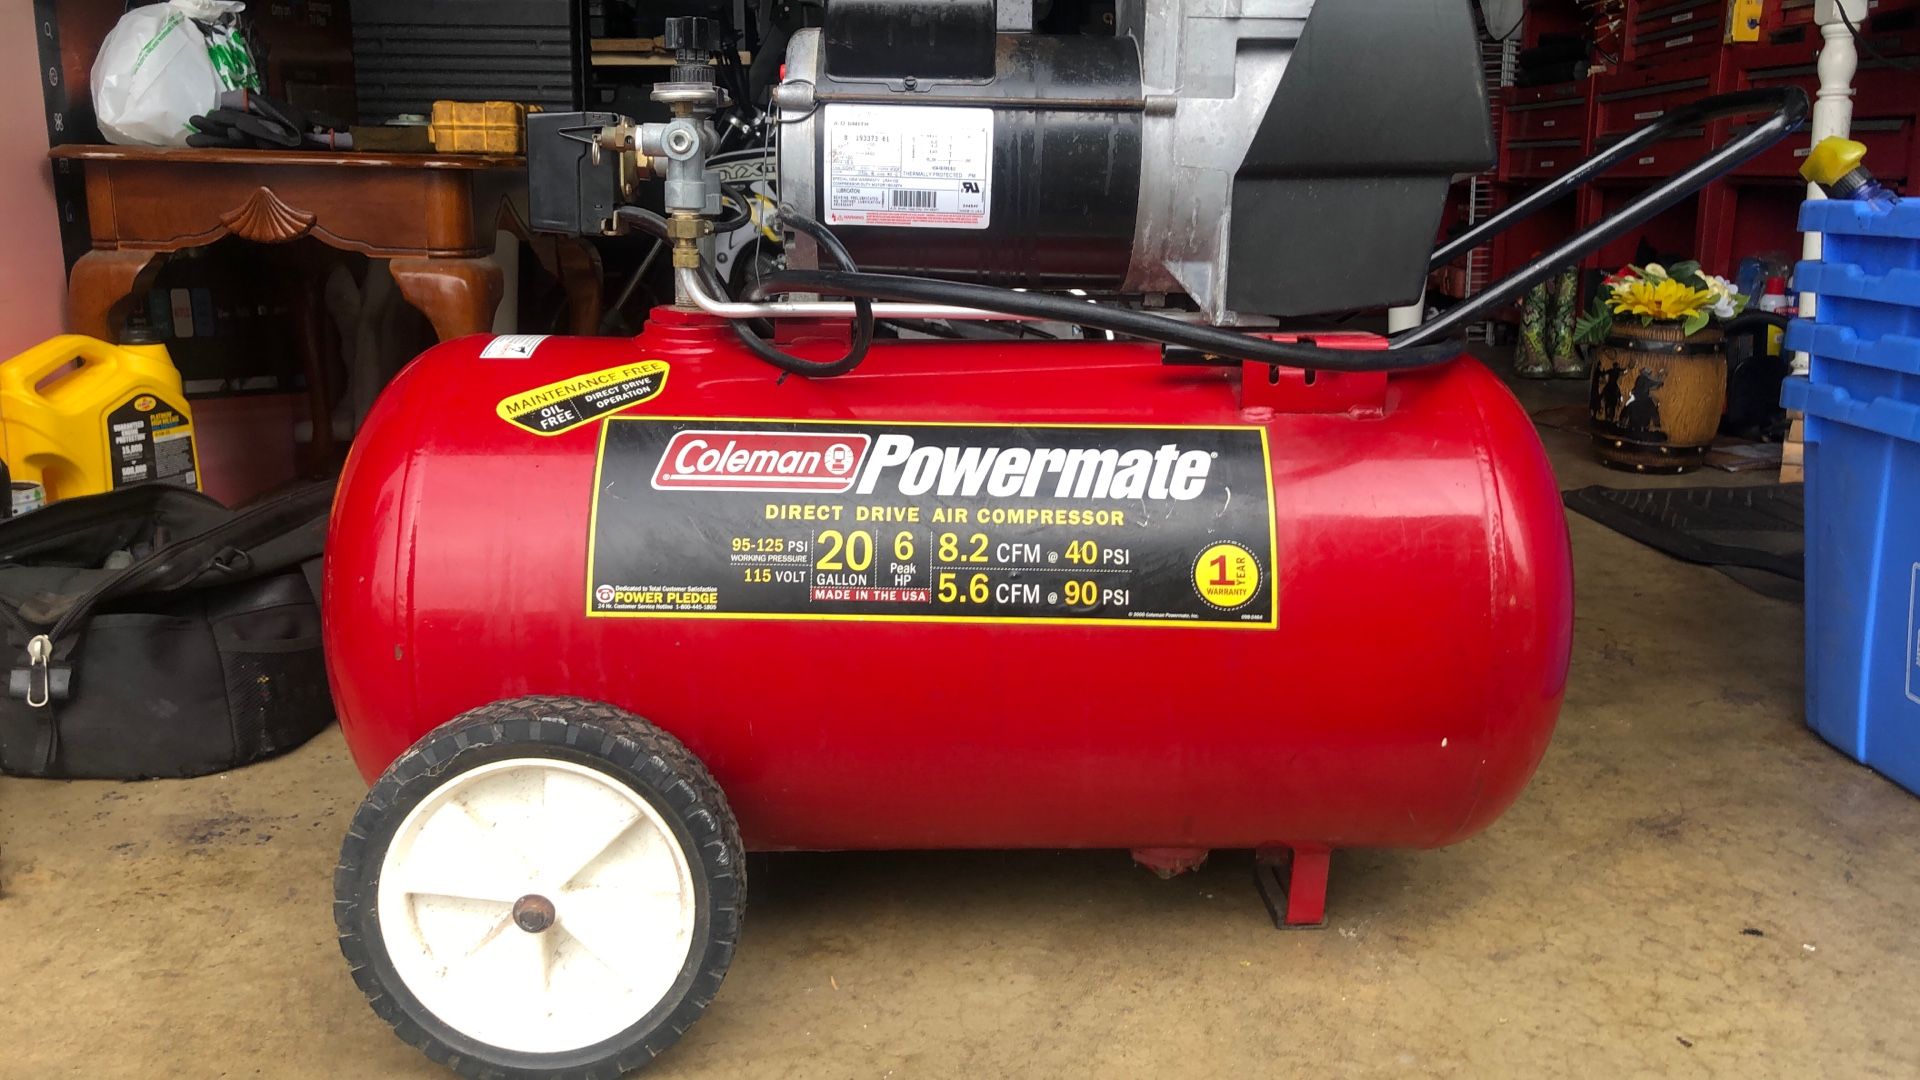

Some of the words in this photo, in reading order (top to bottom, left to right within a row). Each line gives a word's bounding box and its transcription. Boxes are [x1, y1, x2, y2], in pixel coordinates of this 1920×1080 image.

[506, 372, 620, 414] MAINTENANCE
[623, 363, 663, 378] FREE
[585, 386, 620, 403] DIRECT
[622, 377, 652, 391] DRIVE
[596, 386, 651, 409] OPERATION
[540, 410, 575, 430] FREE
[541, 404, 565, 418] OIL
[675, 439, 821, 474] Coleman
[855, 434, 1214, 500] Powermate
[765, 504, 844, 520] DIRECT
[856, 506, 920, 522] DRIVE
[932, 508, 968, 524] AIR
[976, 508, 1124, 526] COMPRESSOR
[732, 537, 784, 552] 95-125
[788, 540, 808, 552] PSI
[816, 529, 874, 571] 20
[894, 530, 914, 561] 6
[938, 532, 990, 564] 8.2
[996, 542, 1040, 564] CFM
[1047, 551, 1059, 564] @
[1064, 540, 1098, 565] 40
[1102, 548, 1130, 565] PSI
[730, 554, 766, 562] WORKING
[768, 554, 808, 563] PRESSURE
[890, 562, 916, 574] Peak
[744, 568, 772, 582] 115
[775, 571, 806, 583] VOLT
[816, 574, 867, 586] GALLON
[894, 574, 912, 586] HP
[1209, 554, 1236, 586] 1
[1236, 557, 1246, 586] YEAR
[614, 592, 662, 604] POWER
[667, 592, 718, 604] PLEDGE
[815, 590, 850, 600] MADE
[856, 590, 868, 600] IN
[874, 590, 897, 600] THE
[902, 591, 926, 601] USA
[938, 572, 990, 604] 5.6
[995, 584, 1040, 604] CFM
[1047, 592, 1058, 605] @
[1064, 580, 1098, 606] 90
[1102, 589, 1130, 606] PSI
[1206, 588, 1247, 596] WARRANTY
